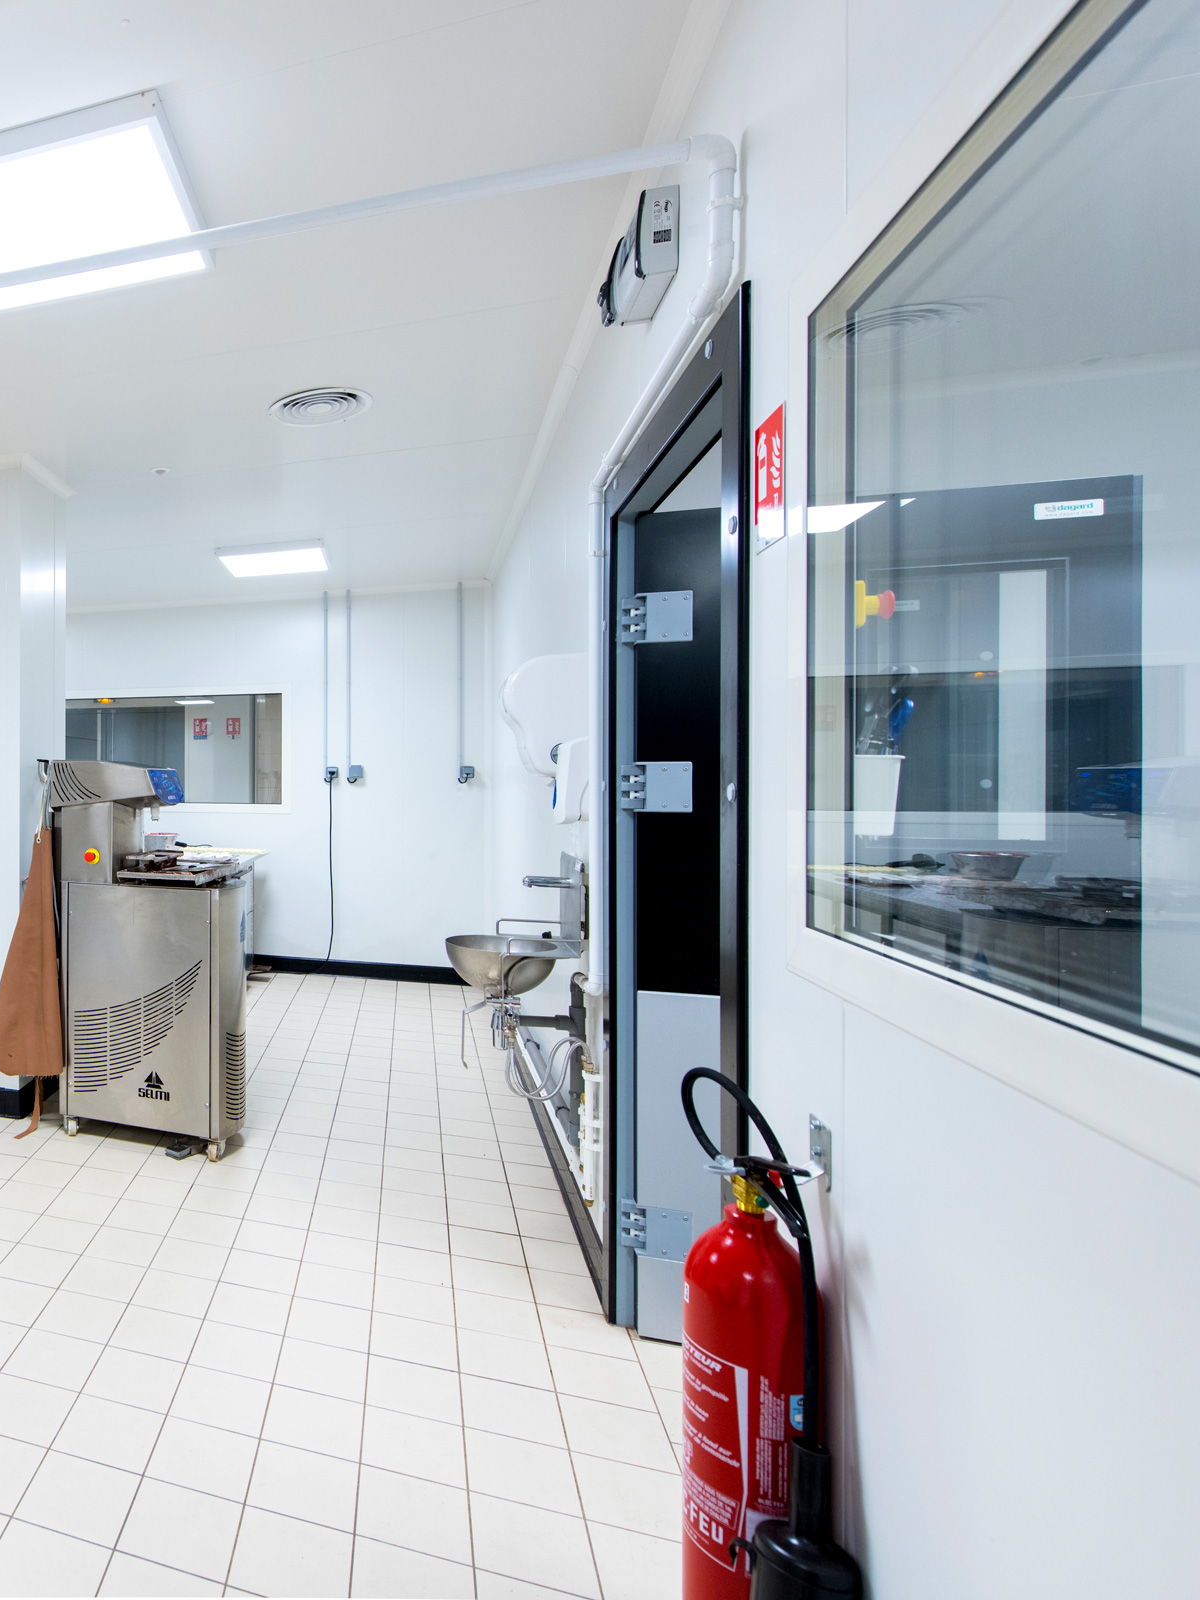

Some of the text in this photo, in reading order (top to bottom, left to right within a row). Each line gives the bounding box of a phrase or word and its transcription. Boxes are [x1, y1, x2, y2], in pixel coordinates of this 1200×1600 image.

[1057, 502, 1094, 511] dagard
[138, 1087, 170, 1102] SELMI
[701, 1443, 740, 1468] commande
